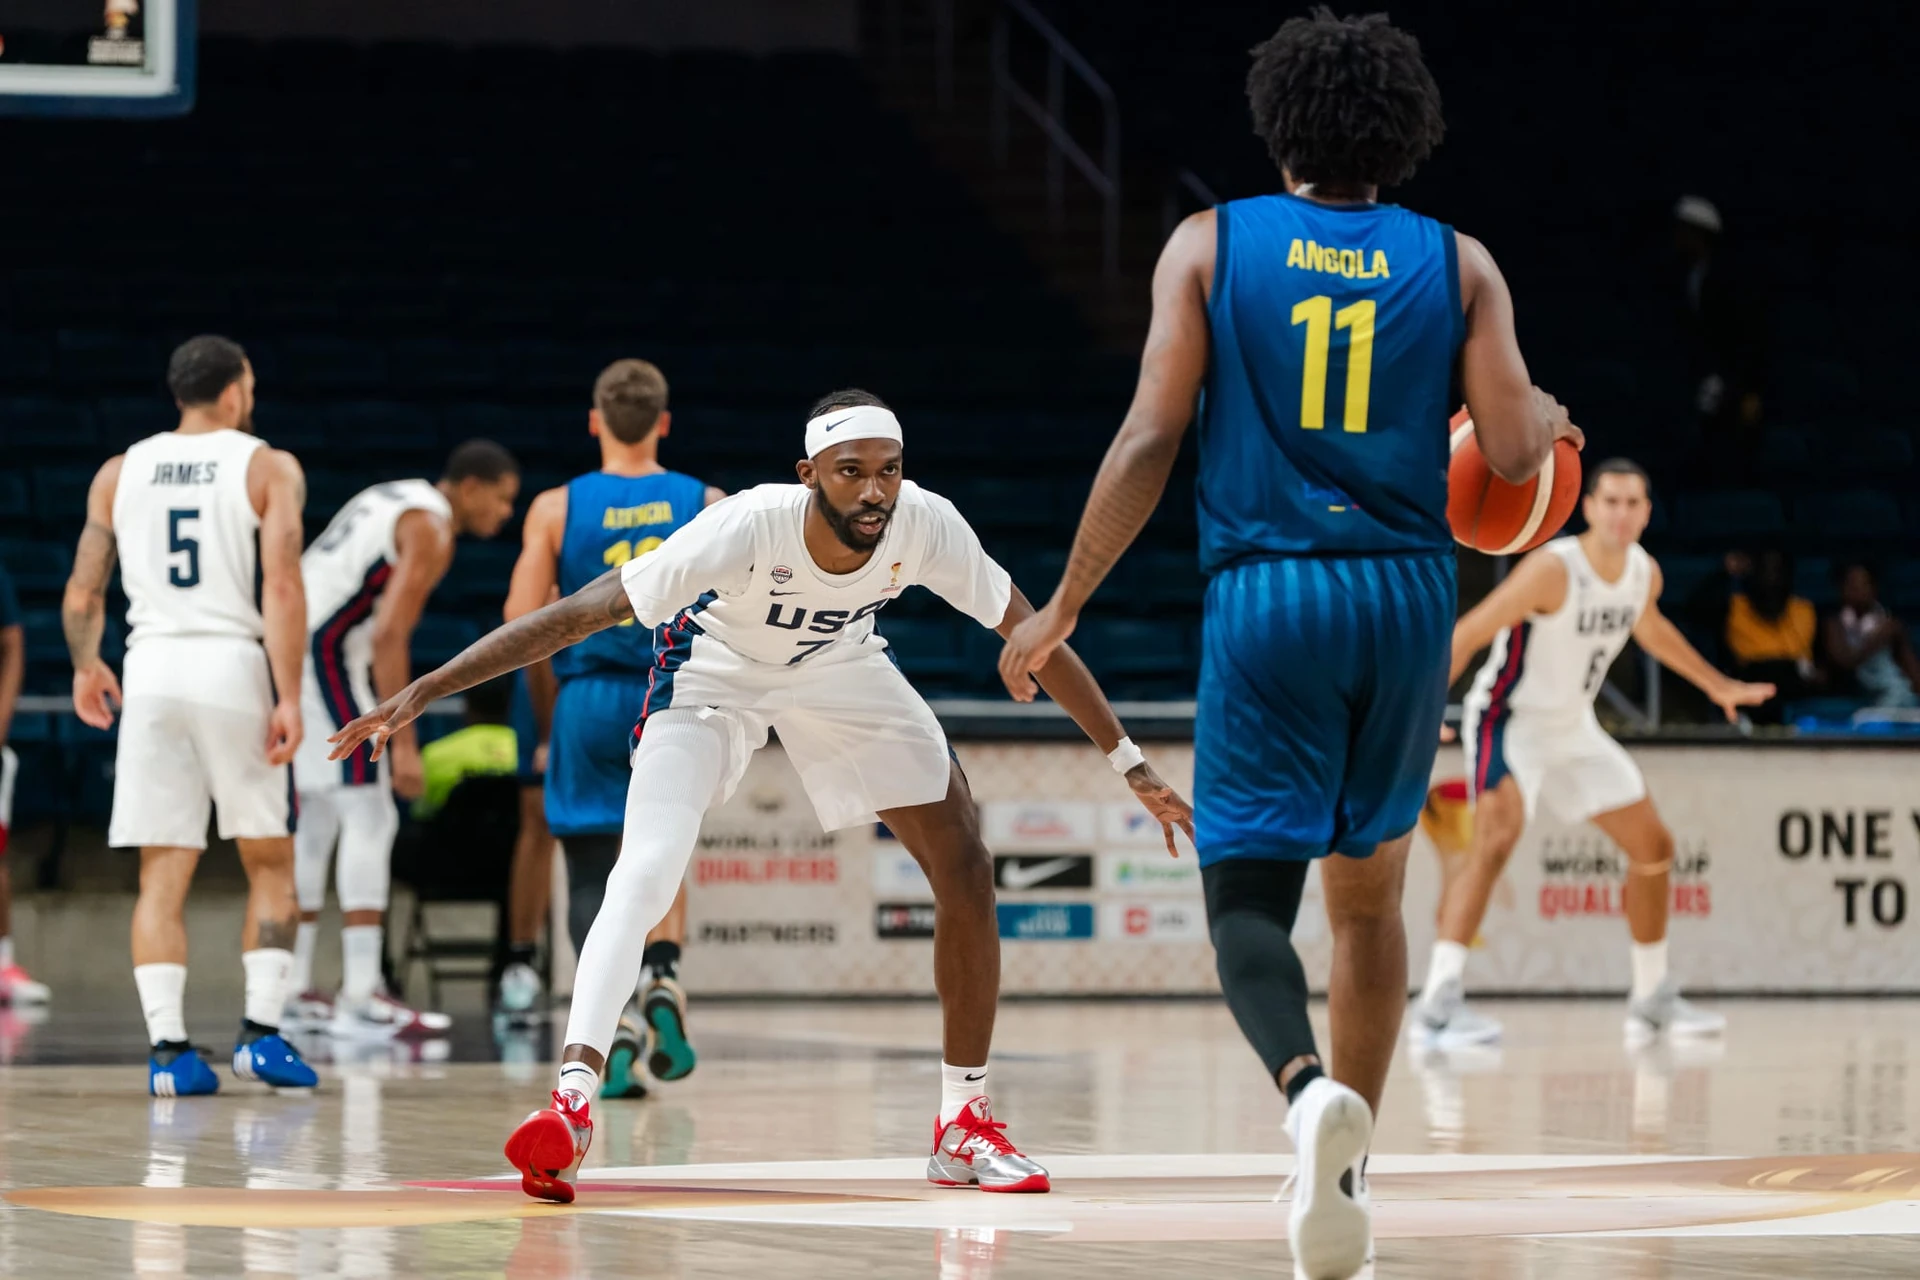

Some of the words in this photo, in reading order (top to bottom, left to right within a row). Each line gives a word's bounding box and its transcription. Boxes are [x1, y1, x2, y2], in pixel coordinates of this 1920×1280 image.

[1287, 238, 1390, 279] ANGOLA
[1291, 295, 1376, 433] 11
[151, 461, 218, 485] JAMES
[168, 508, 200, 588] 5
[785, 639, 836, 666] 7
[1778, 809, 1893, 860] ONE
[1544, 857, 1626, 876] WORL
[1834, 877, 1907, 928] TO
